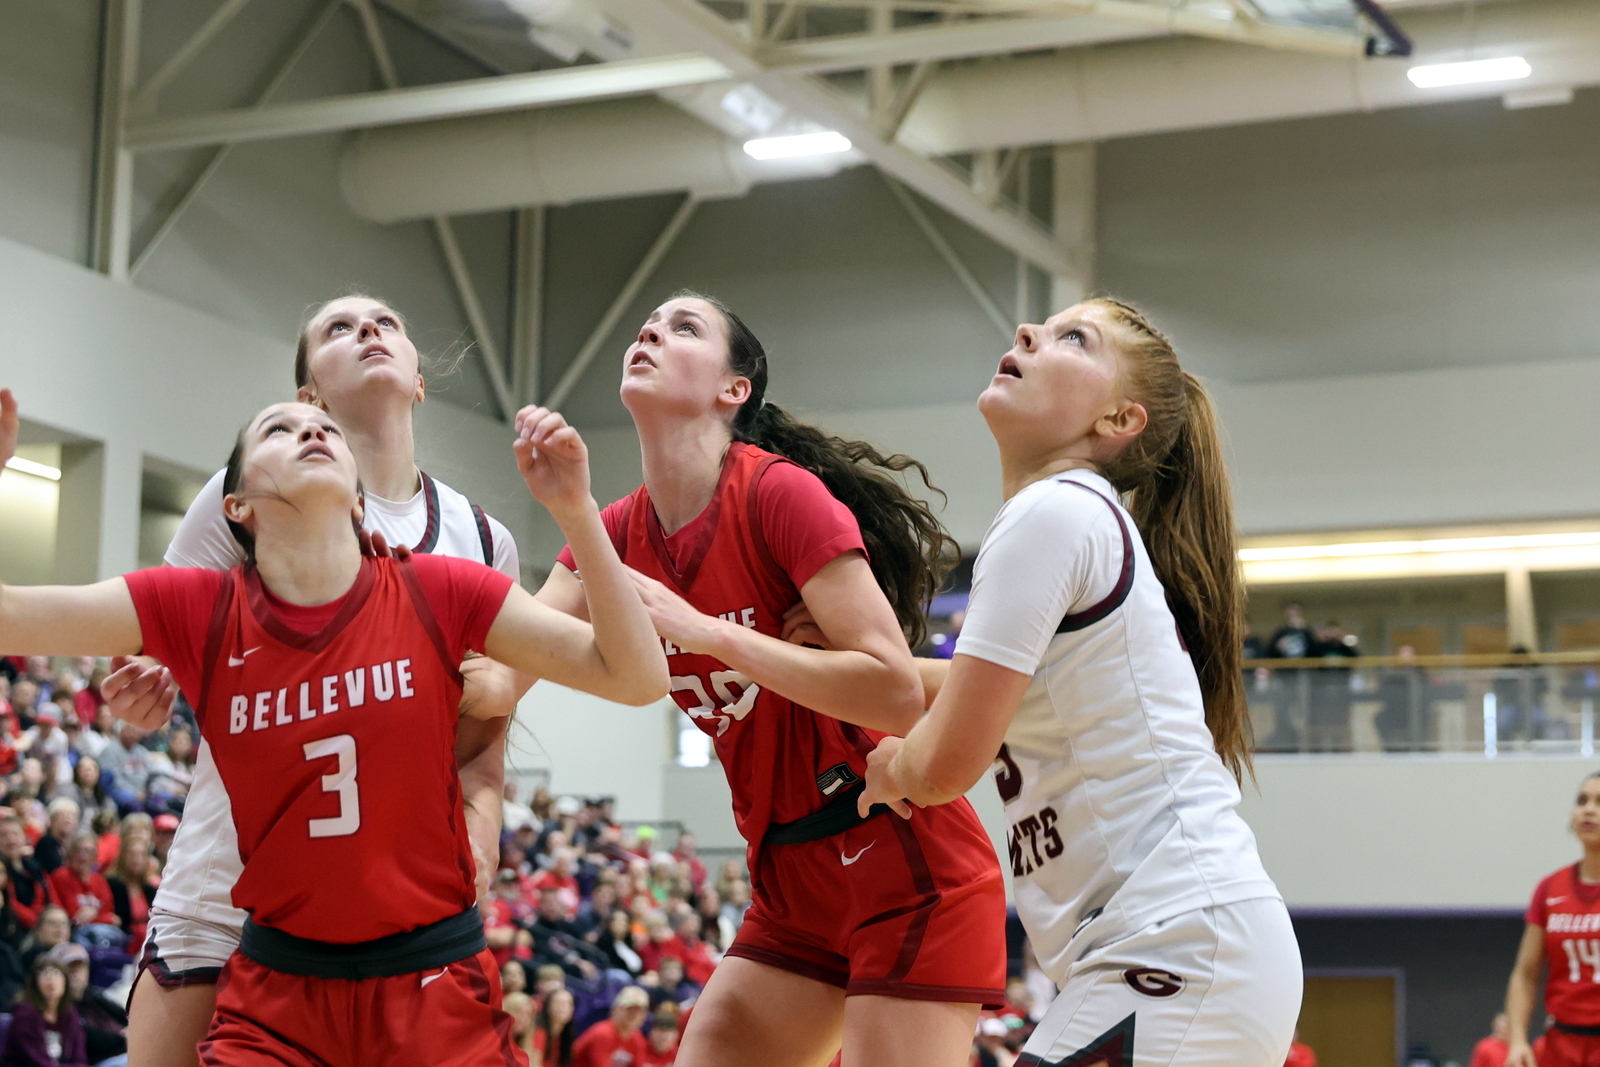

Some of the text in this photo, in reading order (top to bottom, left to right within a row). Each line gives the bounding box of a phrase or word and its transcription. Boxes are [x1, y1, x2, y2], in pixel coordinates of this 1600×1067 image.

[231, 658, 414, 733] BELLEVUE
[303, 735, 361, 838] 3
[1124, 968, 1183, 998] G
[1562, 938, 1600, 984] 14
